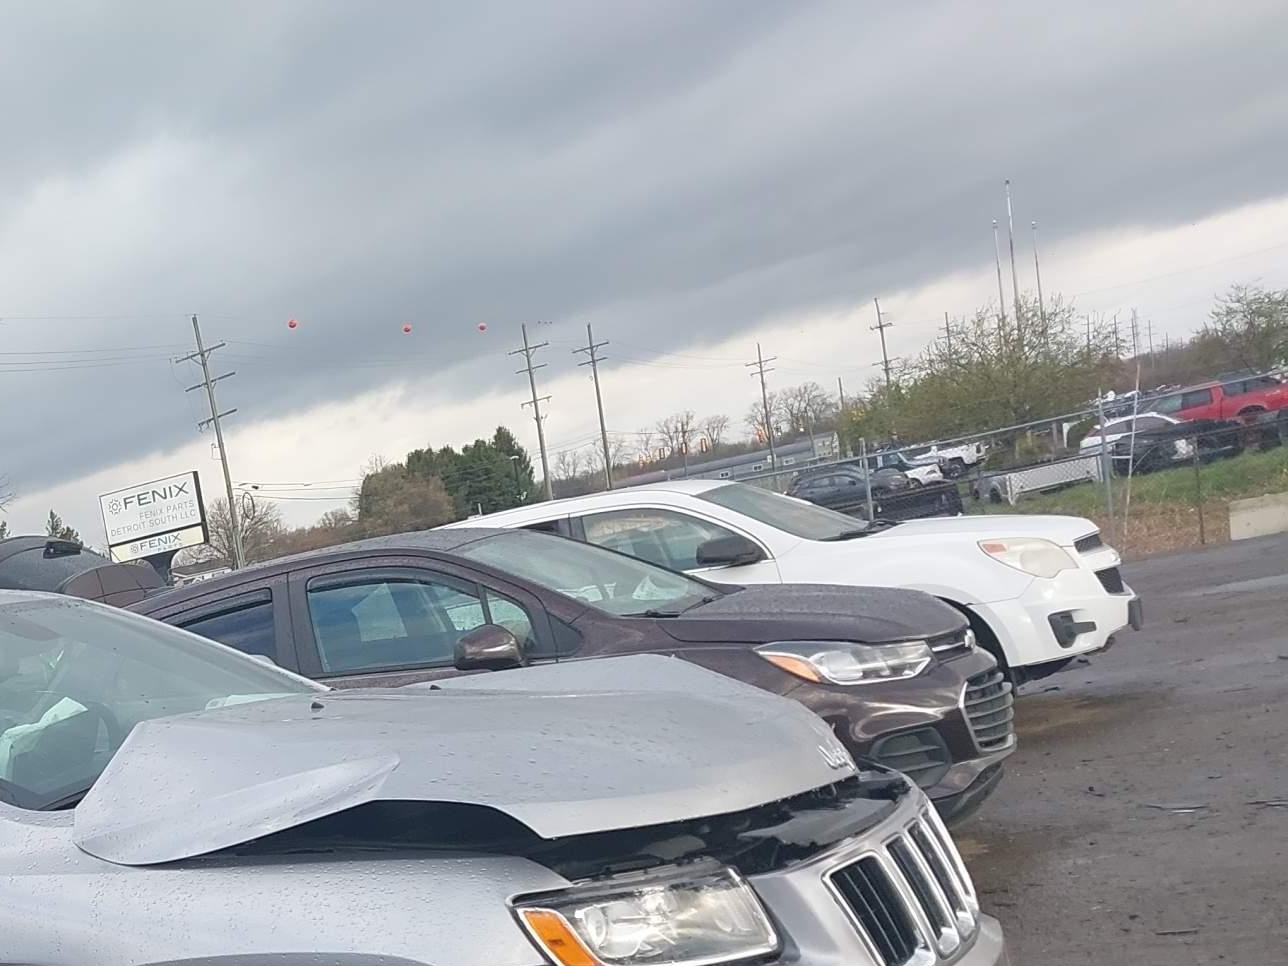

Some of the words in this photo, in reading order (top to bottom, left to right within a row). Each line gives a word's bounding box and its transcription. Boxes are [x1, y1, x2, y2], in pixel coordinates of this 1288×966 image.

[123, 481, 189, 510] FENIX
[166, 500, 195, 512] PARTS
[110, 521, 146, 537] DETROIT
[149, 514, 179, 528] SOUTH
[180, 509, 196, 519] LLC
[140, 533, 182, 551] FENIX
